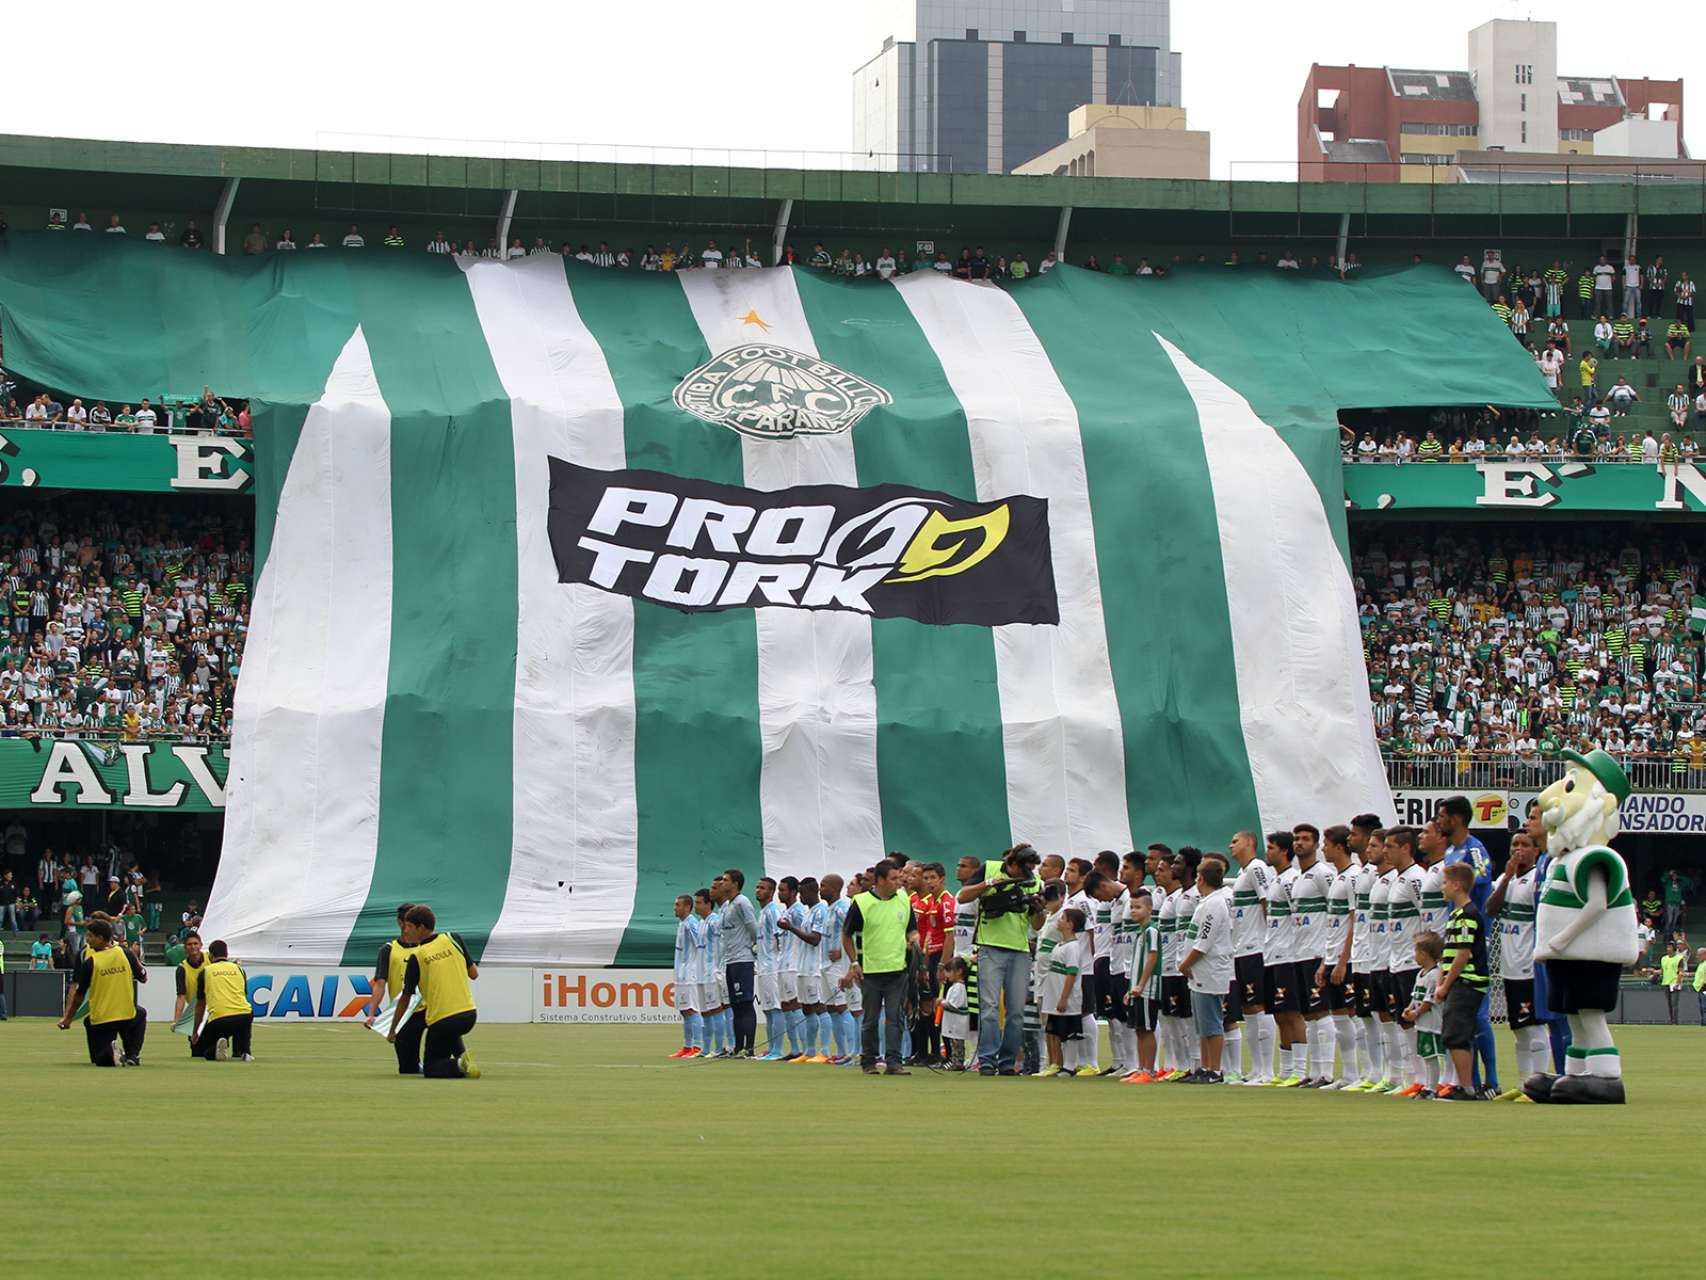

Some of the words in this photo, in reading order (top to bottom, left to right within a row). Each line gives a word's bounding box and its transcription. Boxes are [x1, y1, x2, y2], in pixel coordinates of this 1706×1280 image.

[723, 347, 806, 369] FOOT
[807, 363, 869, 397] BALL
[586, 486, 836, 557] PRO
[576, 536, 894, 613] TORK
[1620, 796, 1685, 814] ANDO
[1618, 813, 1706, 832] NSADOR
[540, 1013, 578, 1022] Sistema
[581, 1012, 638, 1022] Construtivo
